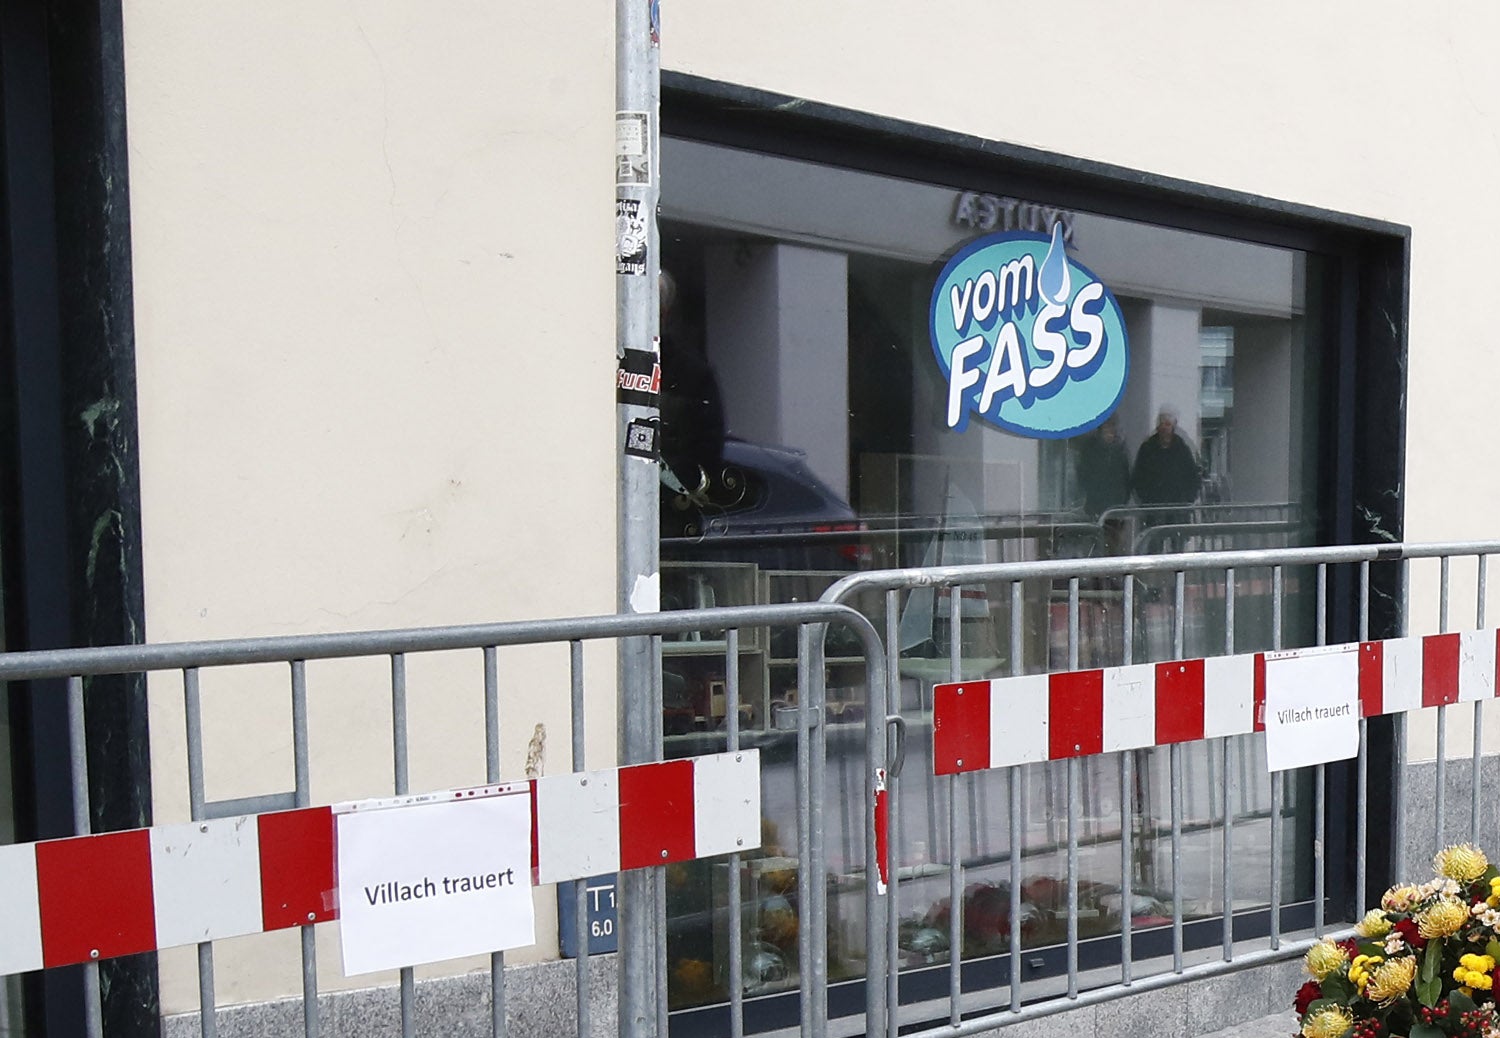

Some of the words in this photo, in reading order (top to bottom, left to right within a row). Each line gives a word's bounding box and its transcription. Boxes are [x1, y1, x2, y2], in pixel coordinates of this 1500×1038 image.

[949, 253, 1036, 331] vom
[946, 281, 1105, 428] FASS
[1277, 706, 1313, 725] Villach
[1315, 702, 1350, 720] trauert
[364, 877, 436, 906] Villach
[442, 867, 514, 895] trauert
[591, 918, 613, 937] 6,0
